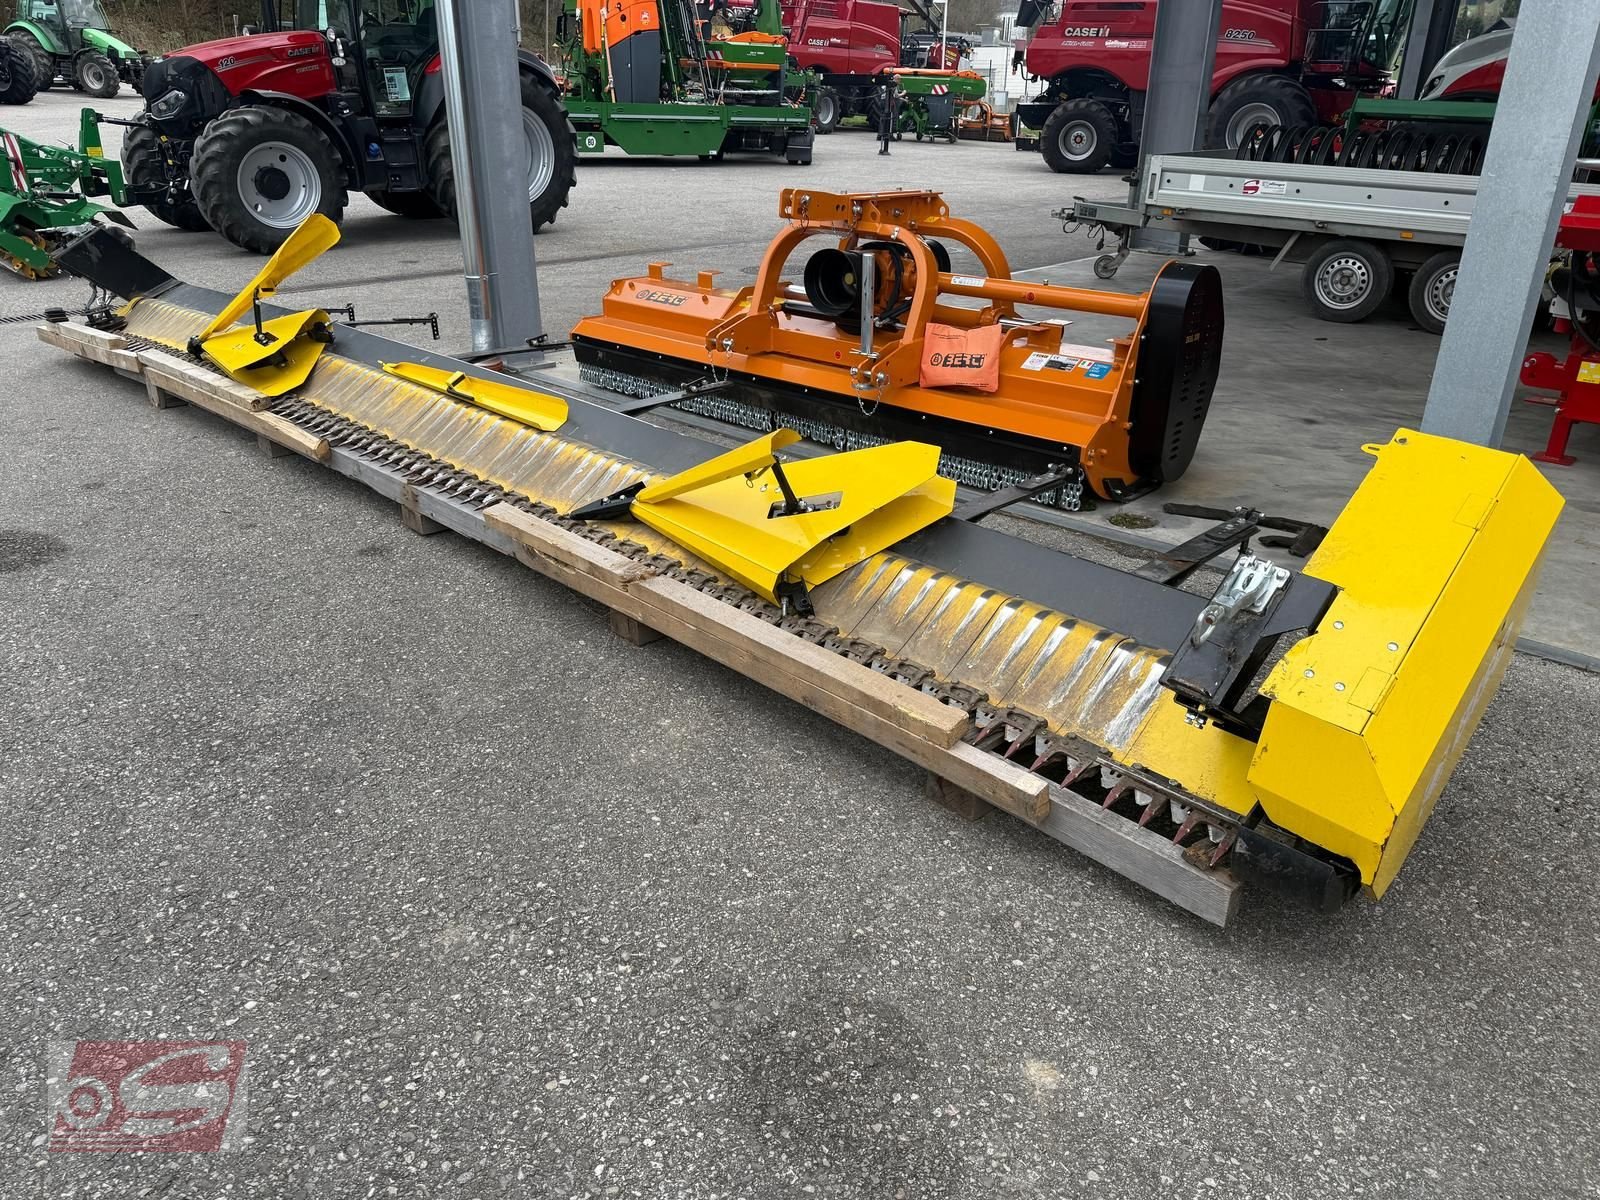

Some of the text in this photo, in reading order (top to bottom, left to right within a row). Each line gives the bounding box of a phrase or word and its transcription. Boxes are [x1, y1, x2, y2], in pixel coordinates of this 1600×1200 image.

[1064, 27, 1098, 37] CASE
[1225, 28, 1256, 40] 8250
[807, 38, 824, 46] CASE
[287, 47, 311, 57] CASE
[219, 55, 236, 67] 120
